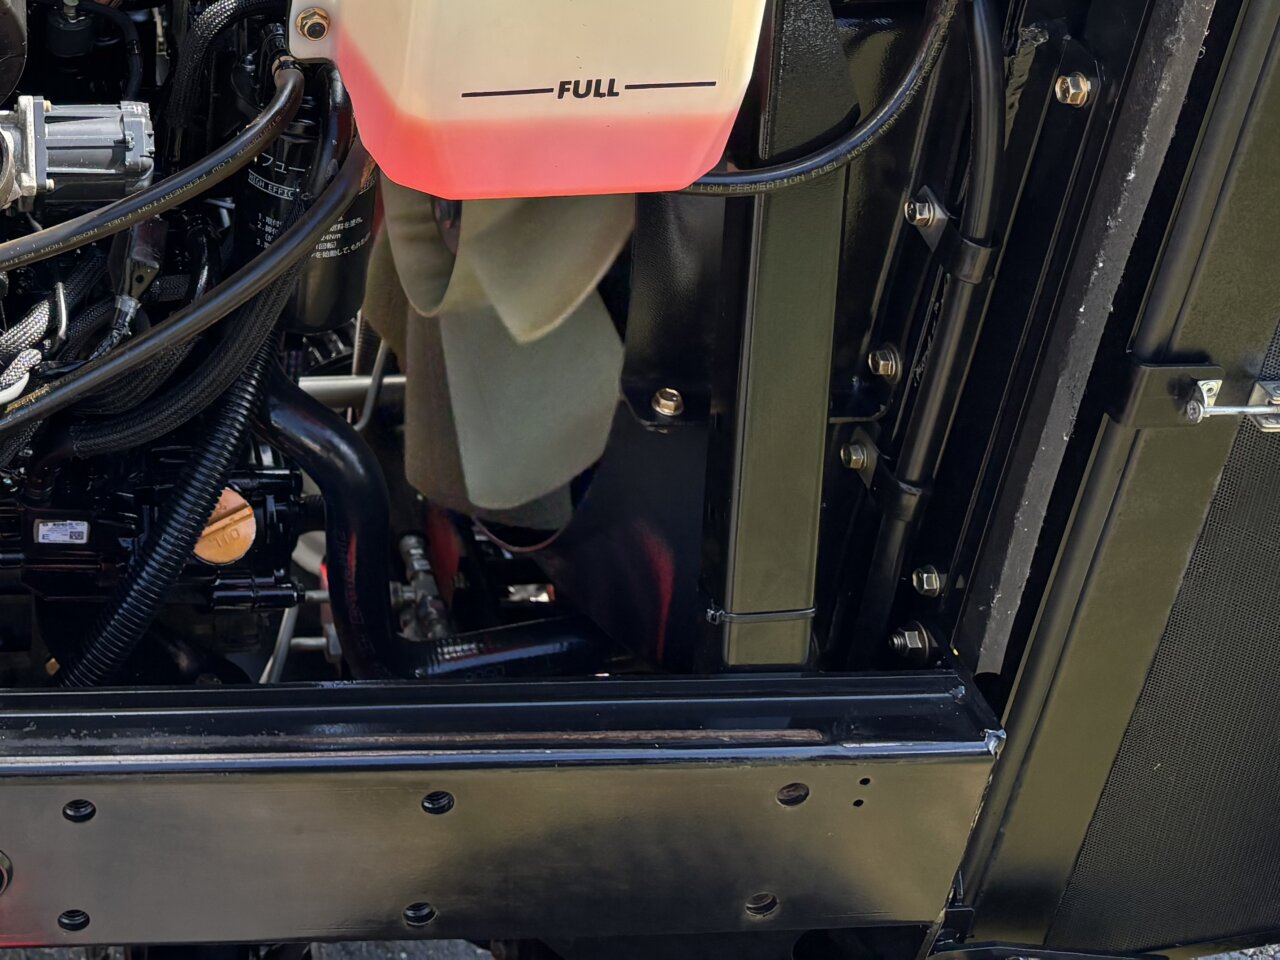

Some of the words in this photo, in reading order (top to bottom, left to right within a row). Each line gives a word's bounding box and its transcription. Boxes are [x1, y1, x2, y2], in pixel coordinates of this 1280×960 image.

[558, 78, 619, 99] FULL
[700, 185, 723, 193] LOW
[729, 174, 805, 192] PERMEATION
[811, 161, 840, 178] FUEL
[847, 136, 874, 160] HOSE
[879, 113, 900, 135] NON
